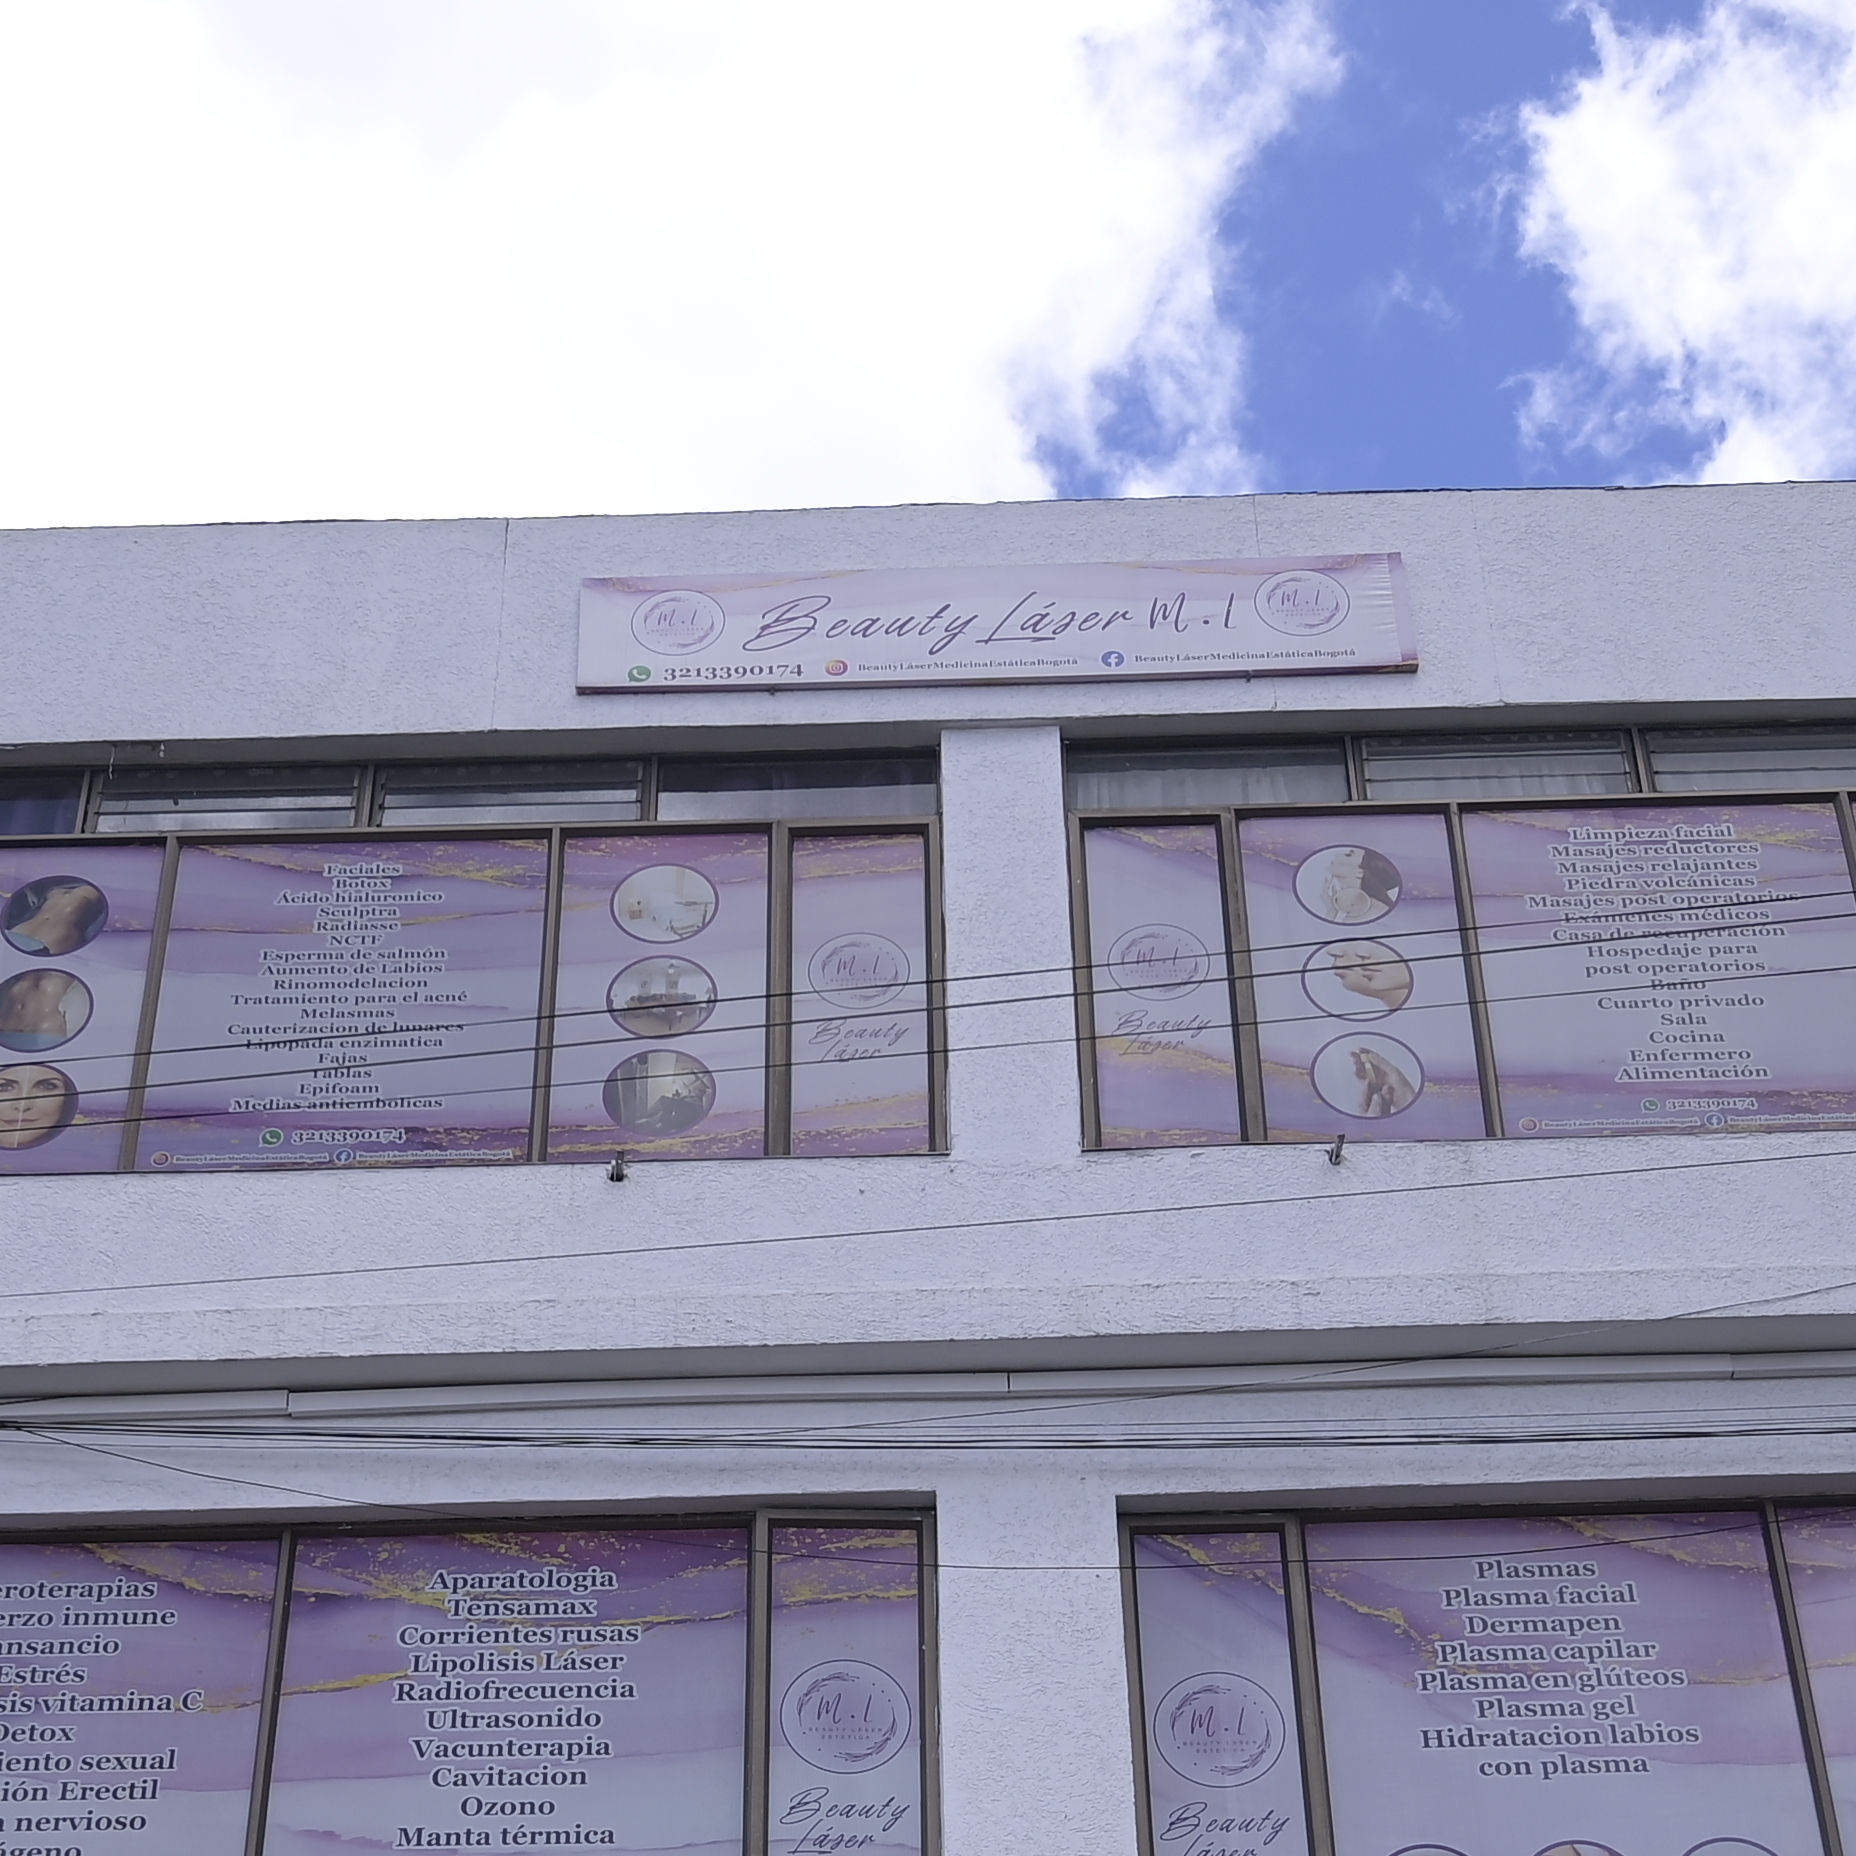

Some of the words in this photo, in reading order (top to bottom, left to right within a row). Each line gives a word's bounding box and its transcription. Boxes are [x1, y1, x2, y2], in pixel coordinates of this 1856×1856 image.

[742, 594, 978, 655] Beauty
[975, 592, 1134, 645] Láser
[664, 663, 804, 681] 3213390174
[1571, 828, 1670, 842] Limpieza
[1676, 826, 1733, 839] facial
[1552, 846, 1636, 859] Masajes
[1644, 843, 1758, 855] reductores
[1558, 862, 1644, 875] Masajes
[1651, 860, 1758, 873] relajantes
[1567, 878, 1636, 890] Piedra
[1644, 876, 1755, 889] volcánicas
[1588, 945, 1702, 958] Hospedaje
[1709, 944, 1758, 957] para
[1586, 964, 1631, 977] post
[1638, 961, 1766, 976] operatorios
[1598, 997, 1673, 1009] Cuarto
[1680, 995, 1764, 1010] privado
[1661, 1014, 1706, 1025] Sala
[1649, 1031, 1725, 1044] Cocina
[1630, 1050, 1751, 1062] Enfermero
[1618, 1067, 1768, 1081] Alimentación
[1476, 1560, 1596, 1579] Plasmas
[429, 1568, 615, 1593] Aparatologia
[1443, 1587, 1549, 1607] Plasma
[1559, 1584, 1637, 1603] facial
[63, 1609, 176, 1626] inmune
[448, 1598, 595, 1617] Tensamax
[400, 1626, 552, 1645] Corrientes
[560, 1626, 639, 1643] rusas
[1466, 1615, 1621, 1636] Dermapen
[1438, 1642, 1544, 1663] Plasma
[1554, 1640, 1657, 1664] capilar
[410, 1652, 534, 1676] Lipolisis
[544, 1651, 623, 1671] Láser
[396, 1678, 634, 1702] Radiofrecuencia
[1418, 1671, 1527, 1691] Plasma
[1536, 1673, 1570, 1689] en
[1579, 1667, 1684, 1692] glúteos
[41, 1691, 173, 1712] vitamina
[181, 1691, 203, 1710] C
[1477, 1699, 1584, 1718] Plasma
[1594, 1695, 1635, 1720] gel
[426, 1707, 601, 1730] Ultrasonido
[1421, 1724, 1601, 1749] Hidratacion
[1610, 1723, 1699, 1744] labios
[80, 1749, 176, 1770] sexual
[412, 1736, 611, 1762] Vacunterapia
[432, 1766, 586, 1787] Cavitacion
[1480, 1759, 1532, 1776] con
[1543, 1754, 1649, 1779] plasma
[58, 1779, 158, 1801] Erectil
[460, 1796, 555, 1817] Ozono
[780, 1787, 910, 1832] Beauty
[15, 1812, 146, 1832] nervioso
[1160, 1802, 1290, 1846] Beauty
[396, 1827, 491, 1847] Manta
[500, 1824, 615, 1845] térmica
[788, 1821, 874, 1855] Láser
